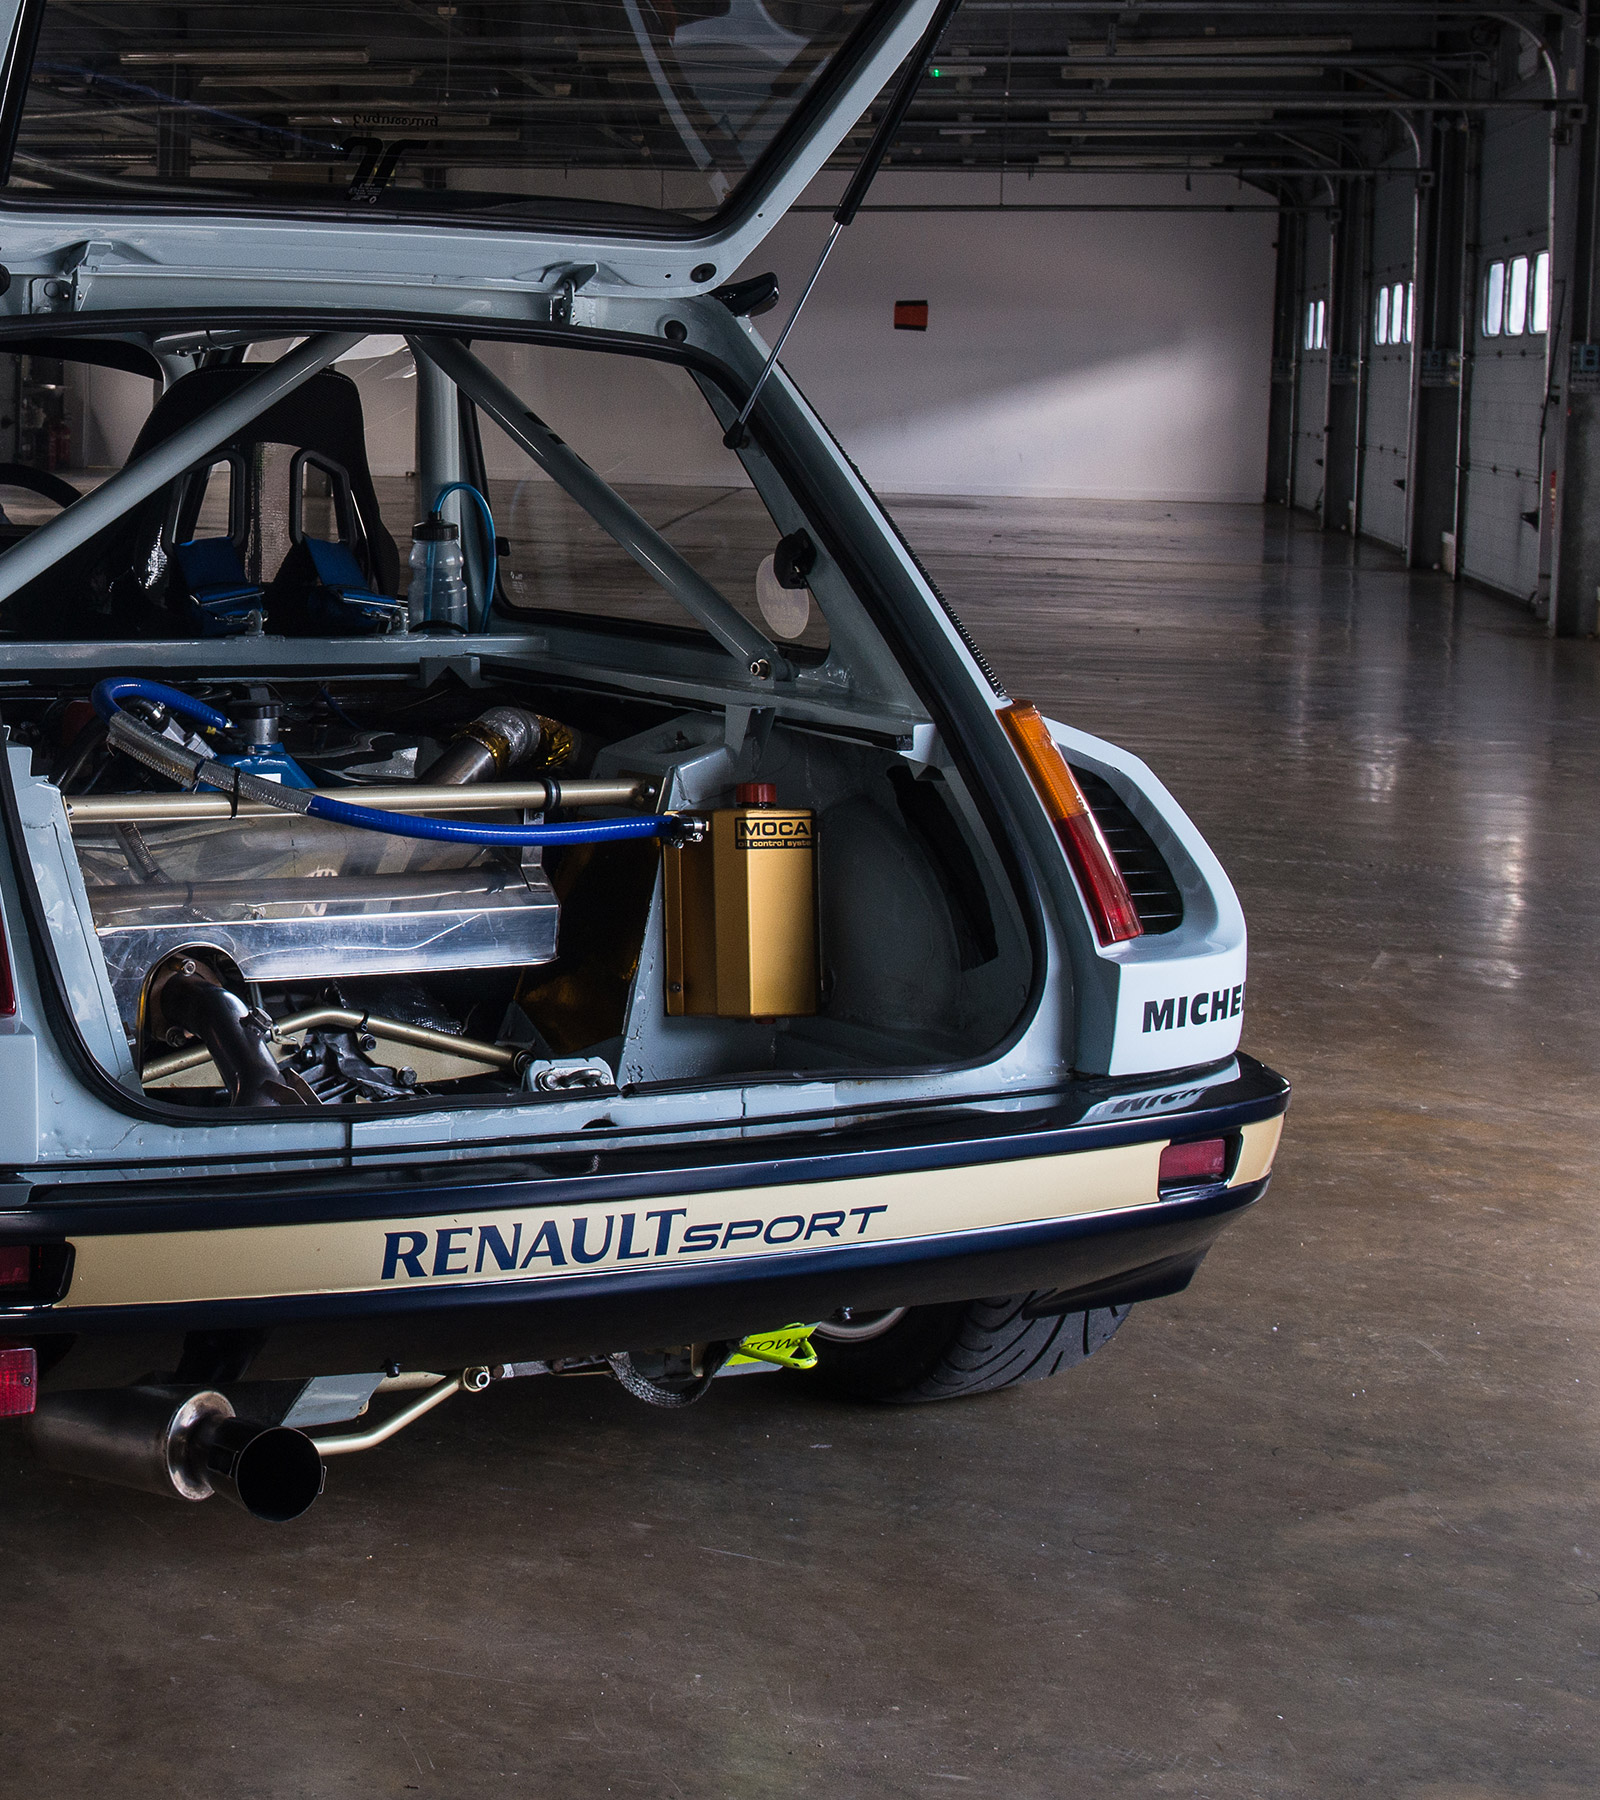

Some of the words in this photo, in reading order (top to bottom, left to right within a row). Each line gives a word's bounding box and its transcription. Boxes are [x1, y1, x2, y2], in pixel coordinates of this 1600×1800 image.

[752, 839, 785, 848] control
[1142, 982, 1246, 1034] MICHE
[380, 1207, 688, 1280] RENAULT
[677, 1204, 889, 1254] SPORT
[740, 1338, 792, 1352] TOW
